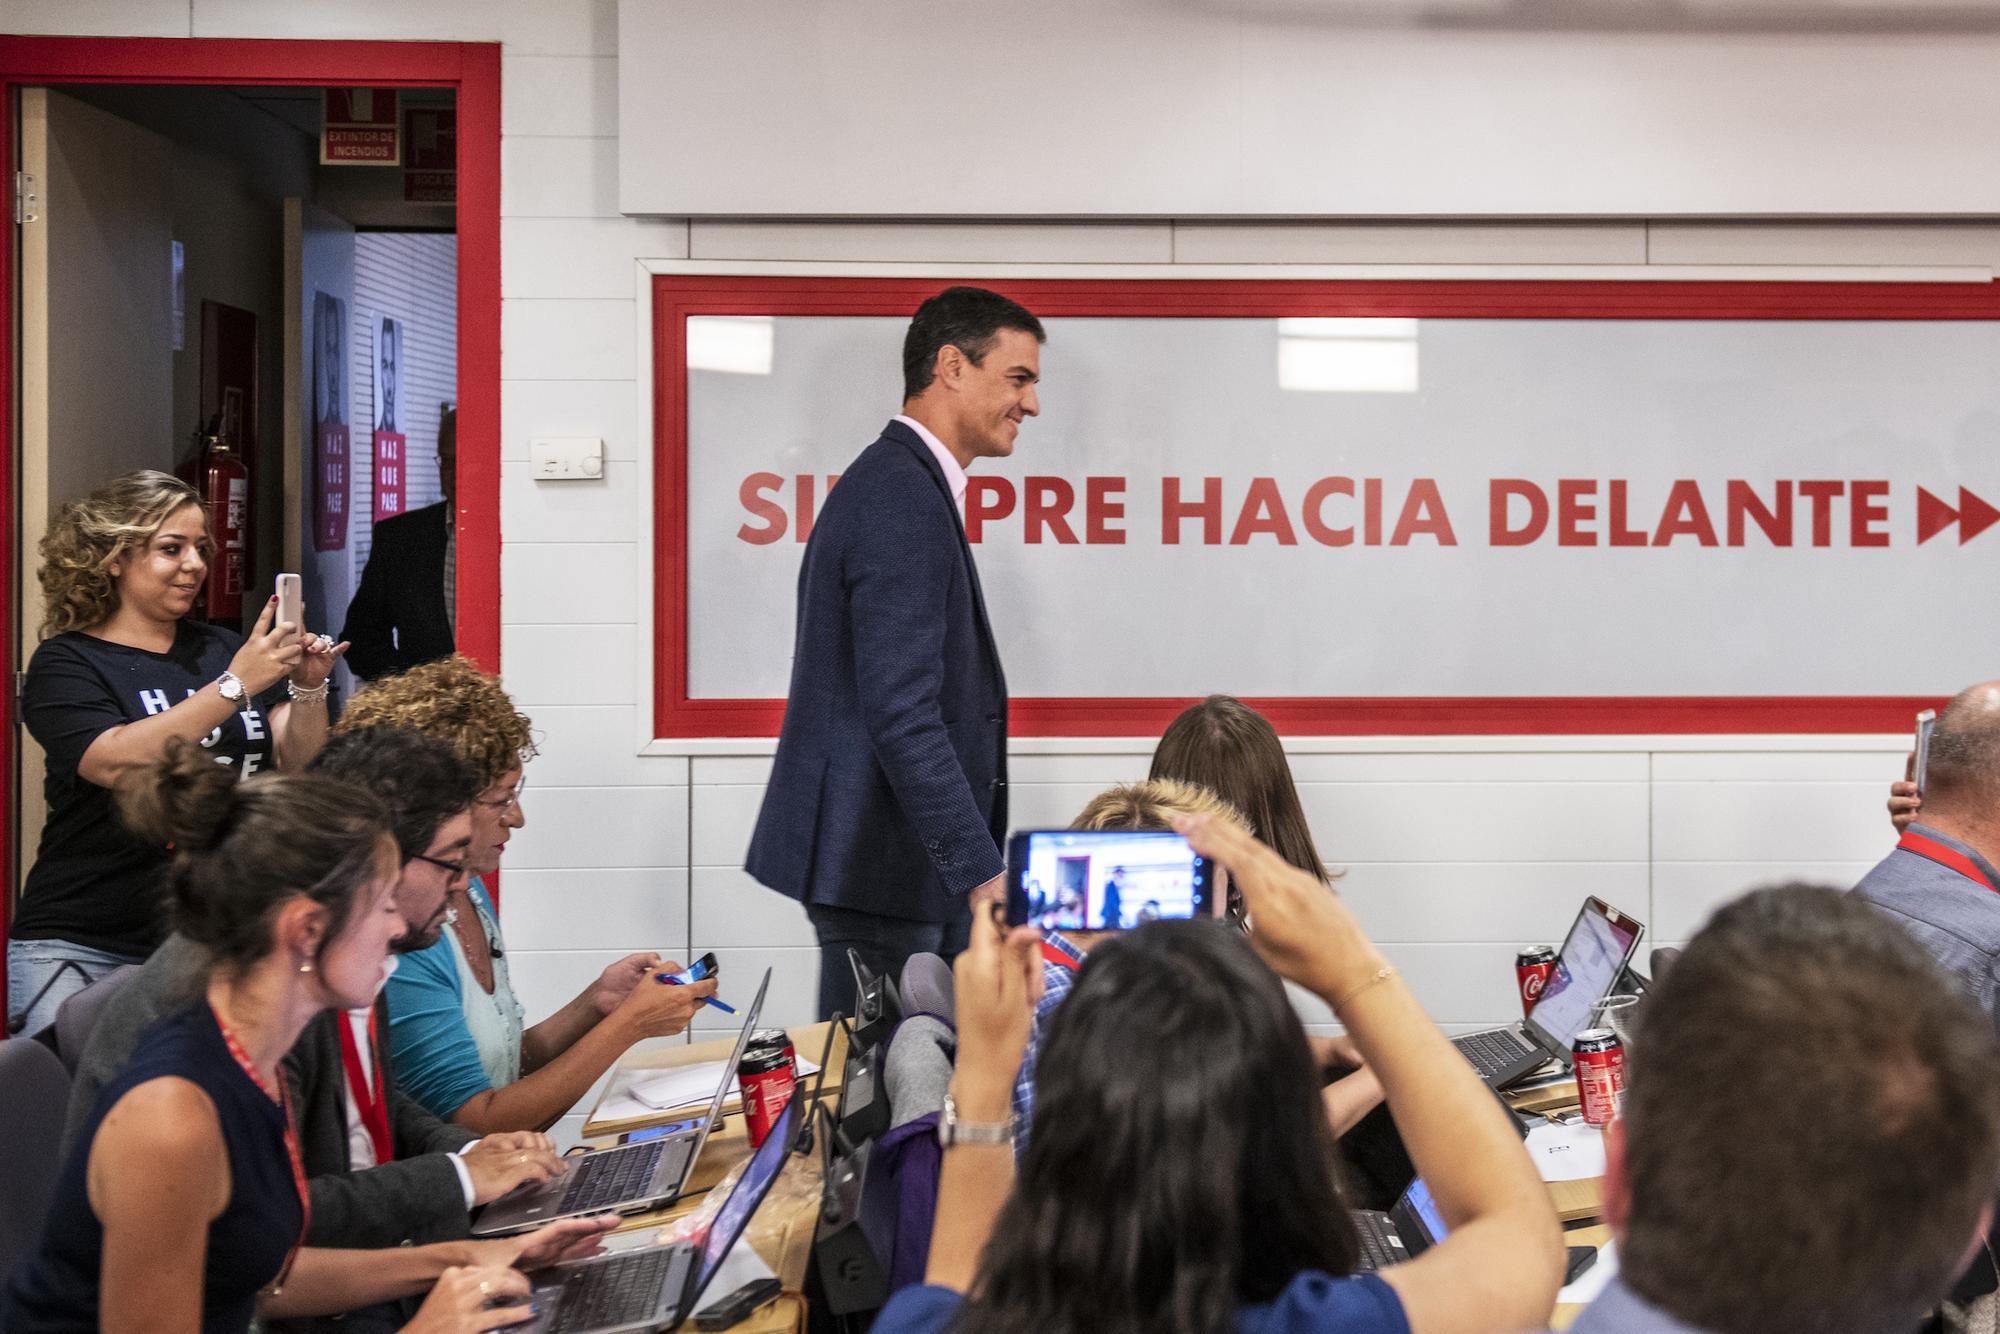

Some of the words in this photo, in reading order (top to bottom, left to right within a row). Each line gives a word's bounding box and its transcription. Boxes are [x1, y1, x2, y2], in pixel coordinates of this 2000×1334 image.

[328, 131, 378, 142] EXTINTOR
[380, 131, 393, 142] DE
[333, 146, 389, 157] INCENDIOS
[381, 439, 398, 460] HAZ
[381, 492, 398, 512] PASE
[736, 471, 1127, 546] SIPRE
[1161, 475, 1459, 548] HACIA
[1488, 478, 1890, 548] DELANTE
